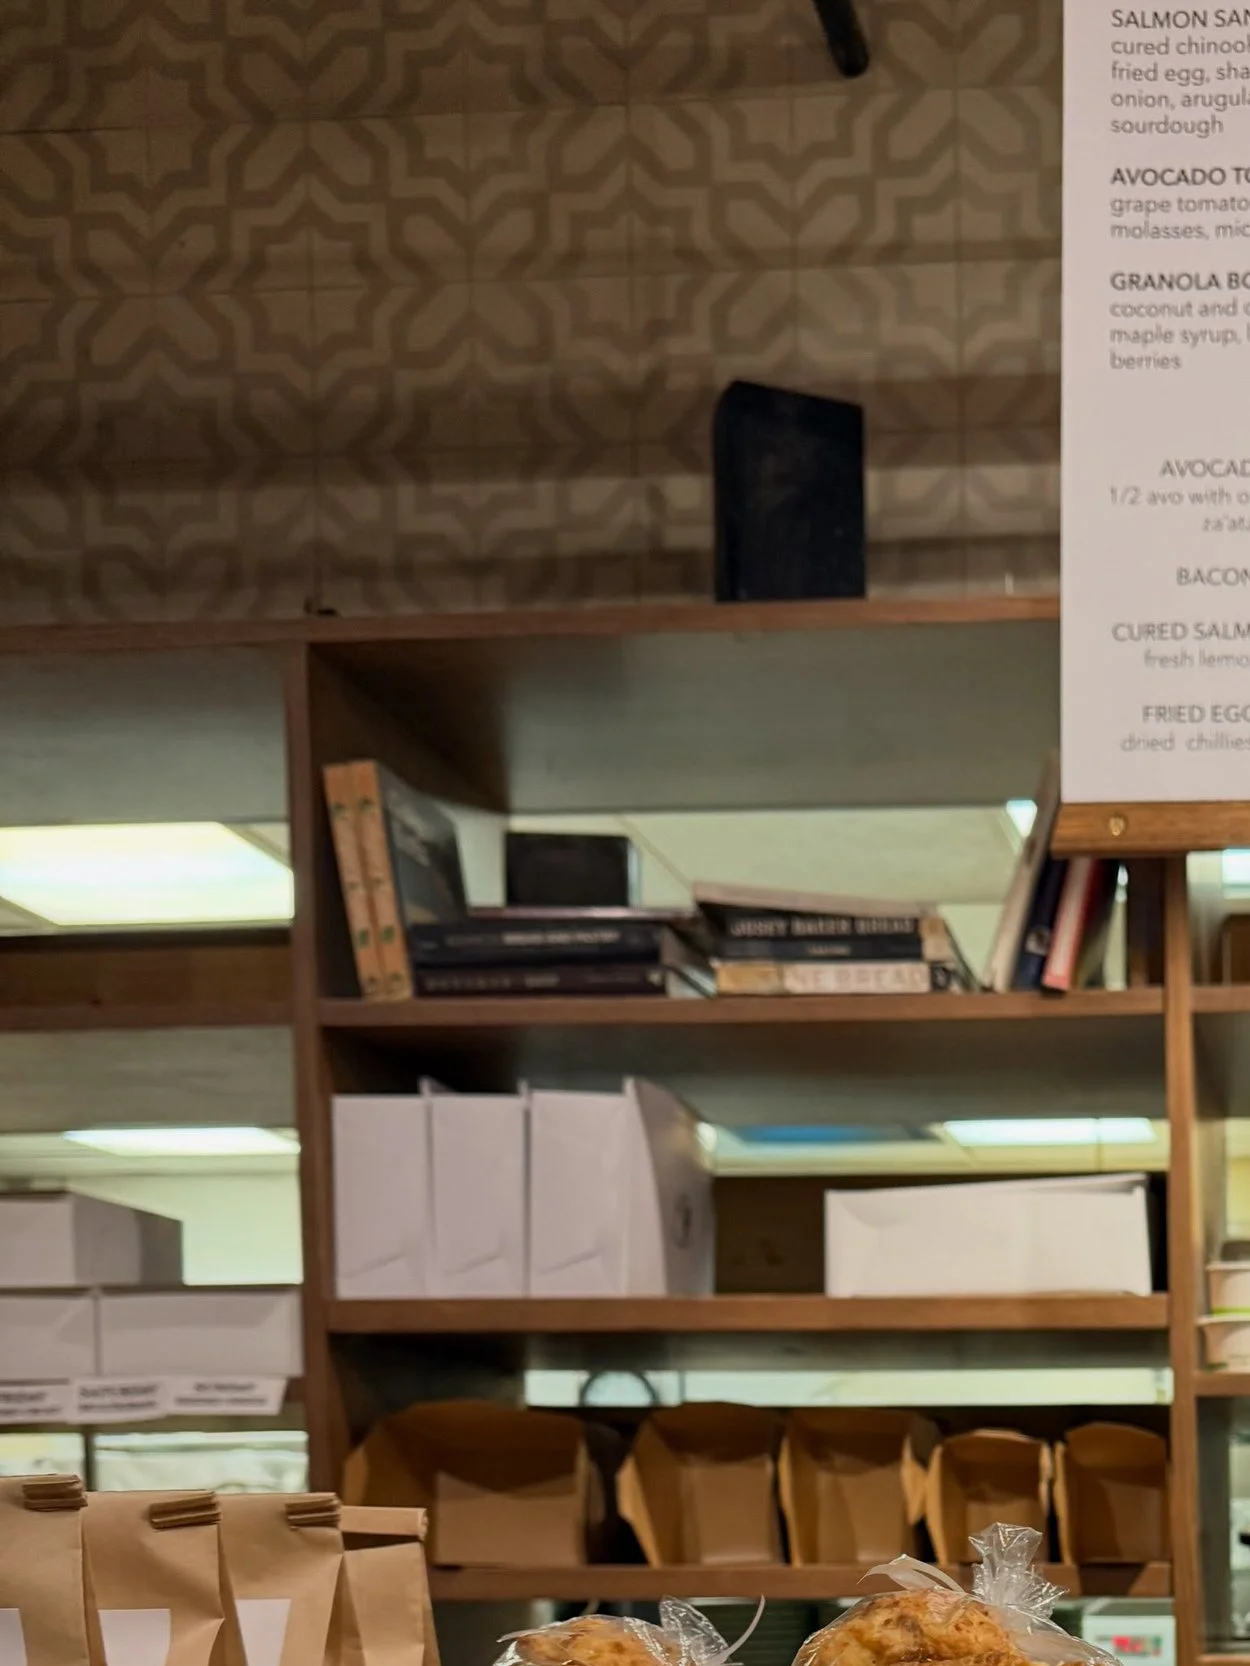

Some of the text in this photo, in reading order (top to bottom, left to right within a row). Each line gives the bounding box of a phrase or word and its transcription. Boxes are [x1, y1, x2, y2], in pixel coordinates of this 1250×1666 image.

[1112, 9, 1208, 29] SALMON
[1111, 35, 1170, 55] cured
[1112, 60, 1158, 82] fried
[1164, 67, 1210, 87] egg,
[1111, 89, 1176, 111] onion,
[1111, 114, 1223, 139] sourdough
[1111, 167, 1226, 186] AVOCADO
[1110, 198, 1172, 219] grape
[1110, 218, 1209, 240] molasses,
[1110, 272, 1221, 291] GRANOLA
[1109, 301, 1193, 318] coconut
[1198, 297, 1238, 317] and
[1110, 324, 1175, 349] maple
[1179, 328, 1241, 349] syrup,
[1110, 349, 1182, 370] berries
[1112, 622, 1189, 642] CURED
[1144, 648, 1194, 669] fresh
[1142, 704, 1206, 723] FRIED
[1120, 731, 1175, 752] dried
